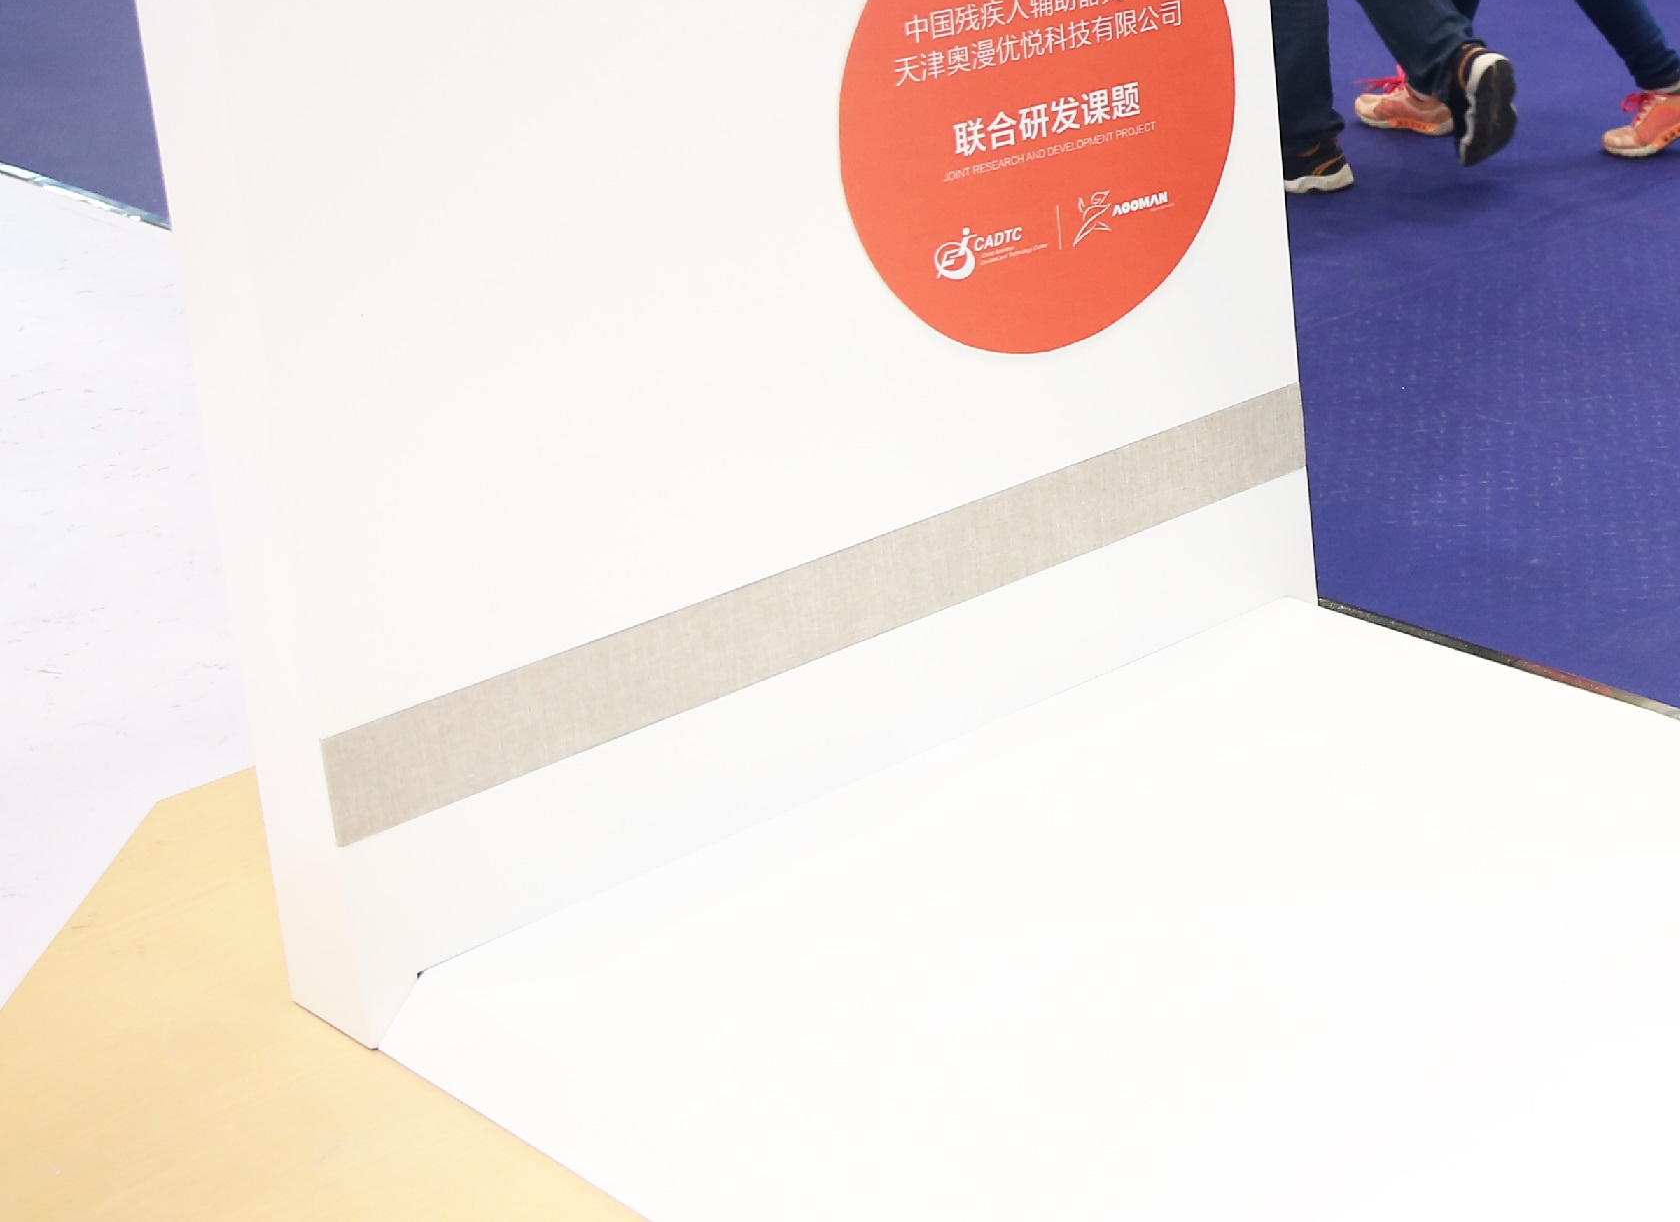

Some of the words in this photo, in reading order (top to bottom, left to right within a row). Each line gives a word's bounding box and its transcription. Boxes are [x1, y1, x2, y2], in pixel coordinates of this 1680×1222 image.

[953, 81, 1142, 158] 联合研发课题
[943, 166, 972, 183] JOINT
[972, 154, 1025, 176] RESEARCH
[1025, 148, 1047, 163] AND
[1046, 131, 1114, 158] DEVELOPMENT
[1114, 120, 1157, 139] PROJECT
[973, 226, 1024, 253] CADTC
